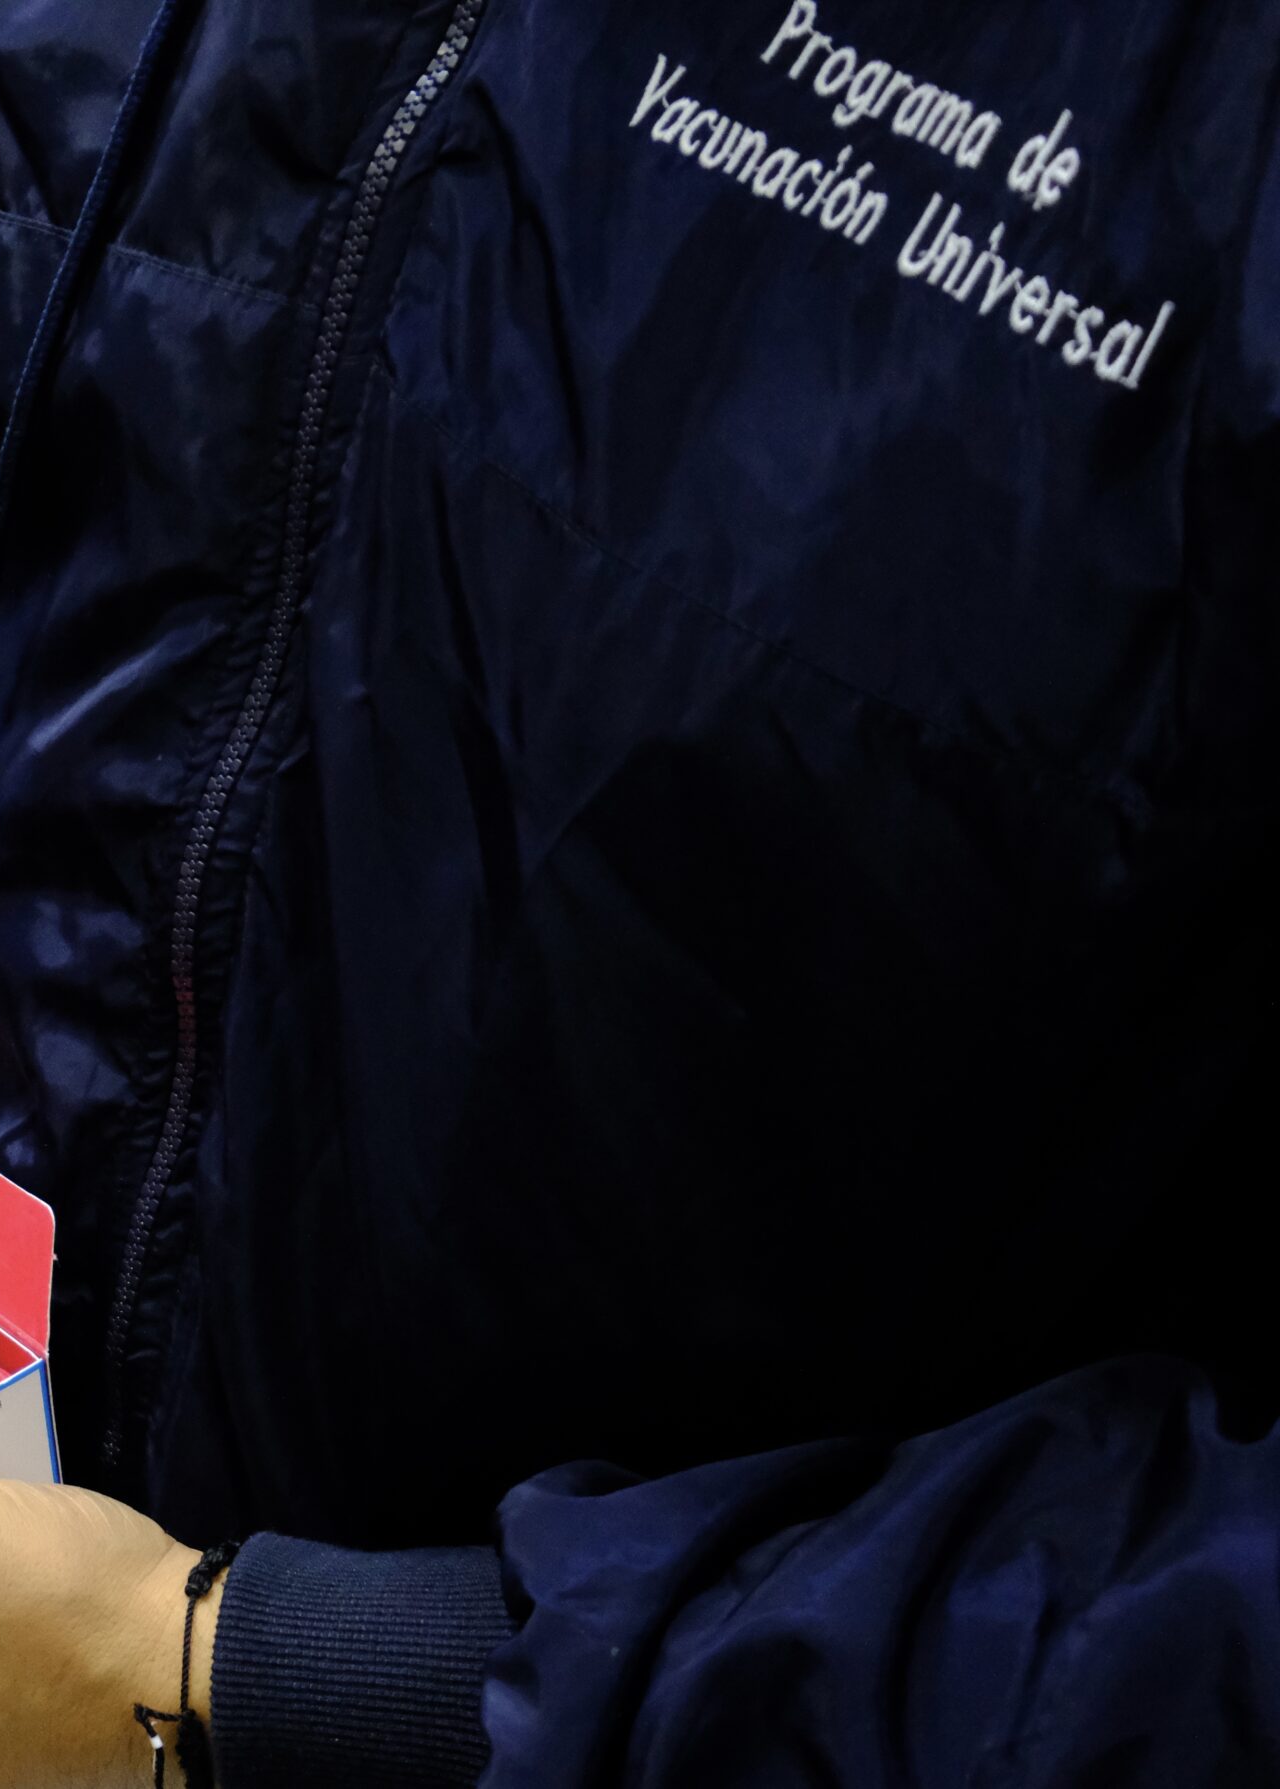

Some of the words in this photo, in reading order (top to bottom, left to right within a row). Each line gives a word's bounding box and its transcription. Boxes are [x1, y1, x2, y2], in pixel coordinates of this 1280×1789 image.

[629, 54, 887, 244] Vacunación
[898, 193, 1174, 388] Universal
[760, 0, 1001, 168] Programa
[1007, 109, 1080, 211] de
